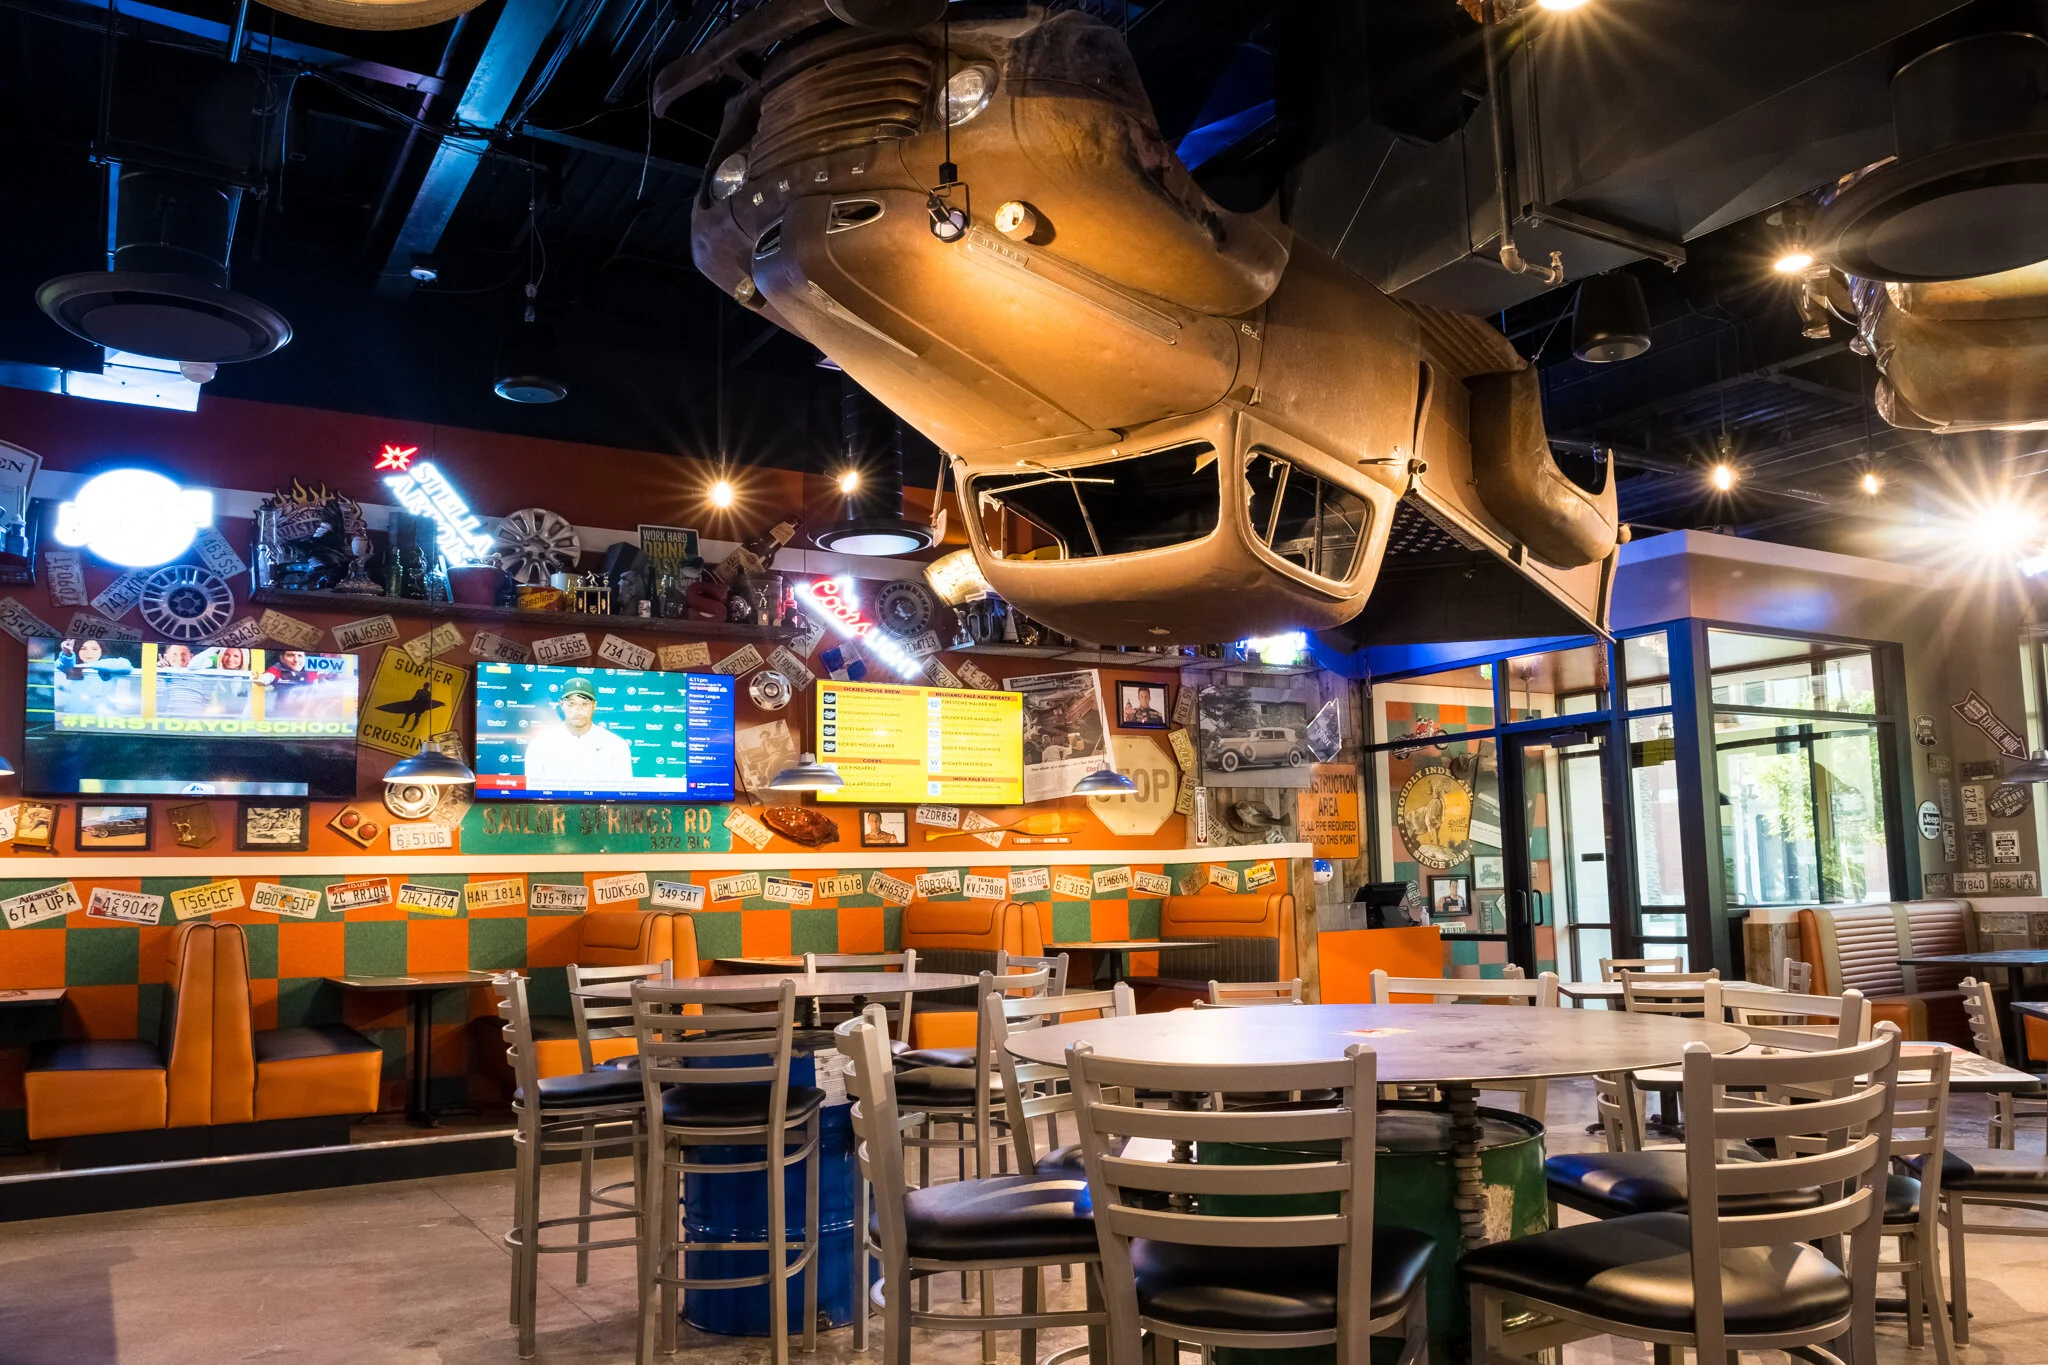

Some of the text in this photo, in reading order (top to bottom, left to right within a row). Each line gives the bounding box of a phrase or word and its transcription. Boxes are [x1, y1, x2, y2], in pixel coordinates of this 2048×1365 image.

[643, 529, 688, 543] WORK HARD
[645, 541, 687, 560] DRINK
[811, 580, 872, 636] Coors
[560, 639, 587, 655] 5695
[603, 641, 623, 660] 734
[307, 658, 345, 673] NOW
[394, 658, 453, 686] SURFER
[62, 715, 354, 736] #FIRSTDAYOFSCHOOL
[1970, 701, 2021, 753] Jeep EXPLORE MORE
[362, 723, 422, 751] CROSSIN
[495, 779, 517, 787] Racing
[1094, 768, 1171, 803] OP
[1300, 774, 1358, 794] NSTRUCTION
[1397, 770, 1422, 825] PROUDLY
[1964, 788, 1978, 822] 232 HPY
[1318, 797, 1339, 817] AREA
[483, 807, 566, 835] SAILOR
[579, 807, 673, 835] SPRINGS
[684, 807, 712, 834] RD
[1315, 820, 1326, 831] PPE
[1327, 820, 1357, 832] REQUIRED
[1924, 814, 1940, 825] Jeep
[650, 836, 712, 849] 3372 BLK
[1325, 834, 1339, 845] THIS
[1339, 834, 1357, 845] POINT
[1413, 850, 1469, 869] SINCE 1909
[350, 880, 370, 889] IDAHO
[598, 883, 645, 900] 7UDK560
[717, 879, 758, 896] BML1202
[819, 879, 863, 894] VR 1618
[19, 888, 60, 905] Arkansas
[467, 887, 521, 904] HAH 1814
[791, 888, 810, 901] 795
[9, 892, 76, 921] 674 UPA
